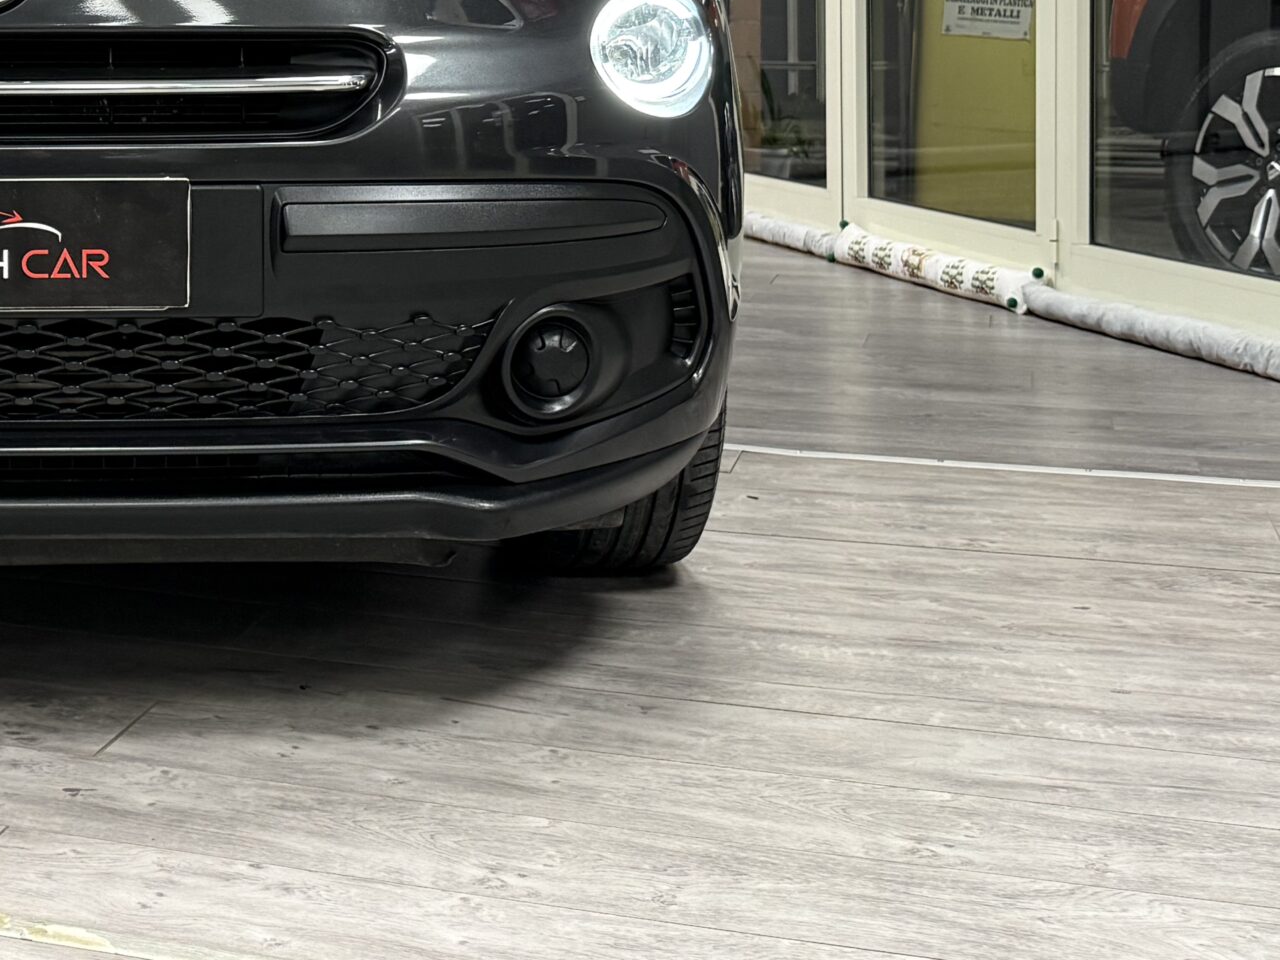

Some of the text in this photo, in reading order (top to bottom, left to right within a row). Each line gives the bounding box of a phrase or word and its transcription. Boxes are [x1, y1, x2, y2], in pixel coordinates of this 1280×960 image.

[958, 5, 1022, 19] E METALLI
[21, 247, 111, 279] CAR
